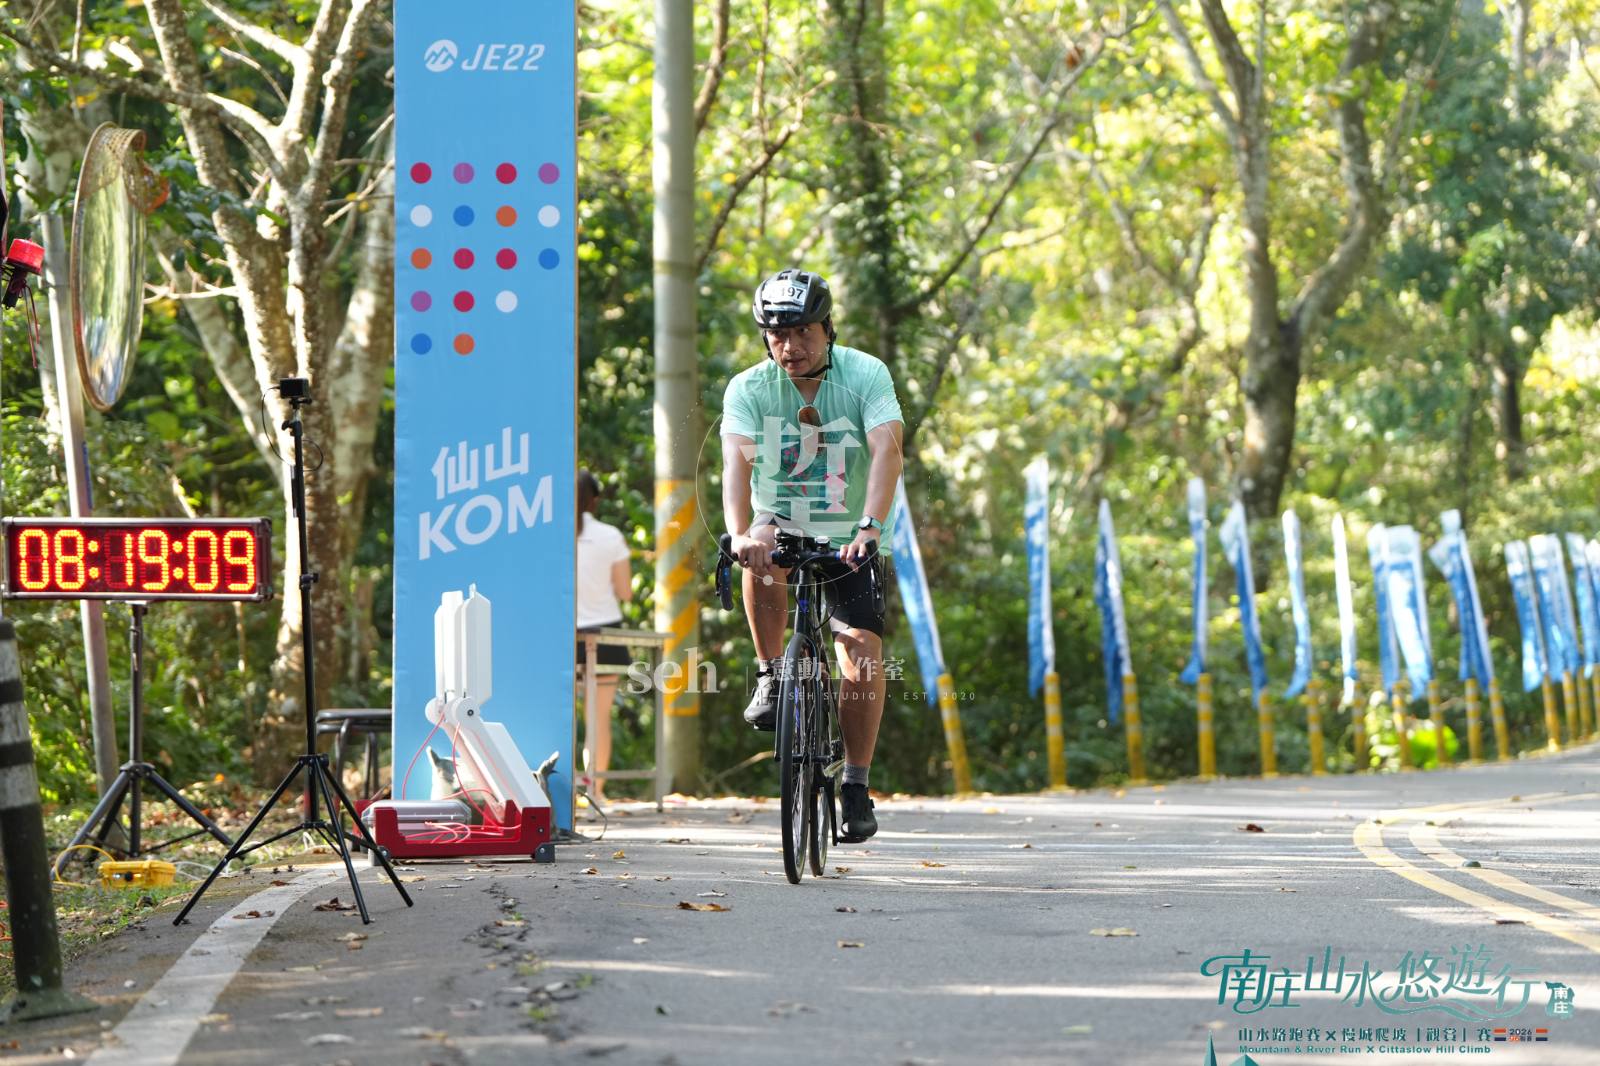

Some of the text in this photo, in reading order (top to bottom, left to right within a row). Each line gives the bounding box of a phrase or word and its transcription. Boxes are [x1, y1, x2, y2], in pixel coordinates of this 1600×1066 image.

[461, 43, 545, 71] JE22
[431, 426, 529, 500] 仙山
[418, 474, 553, 561] KOM
[18, 528, 256, 592] 08:19:09
